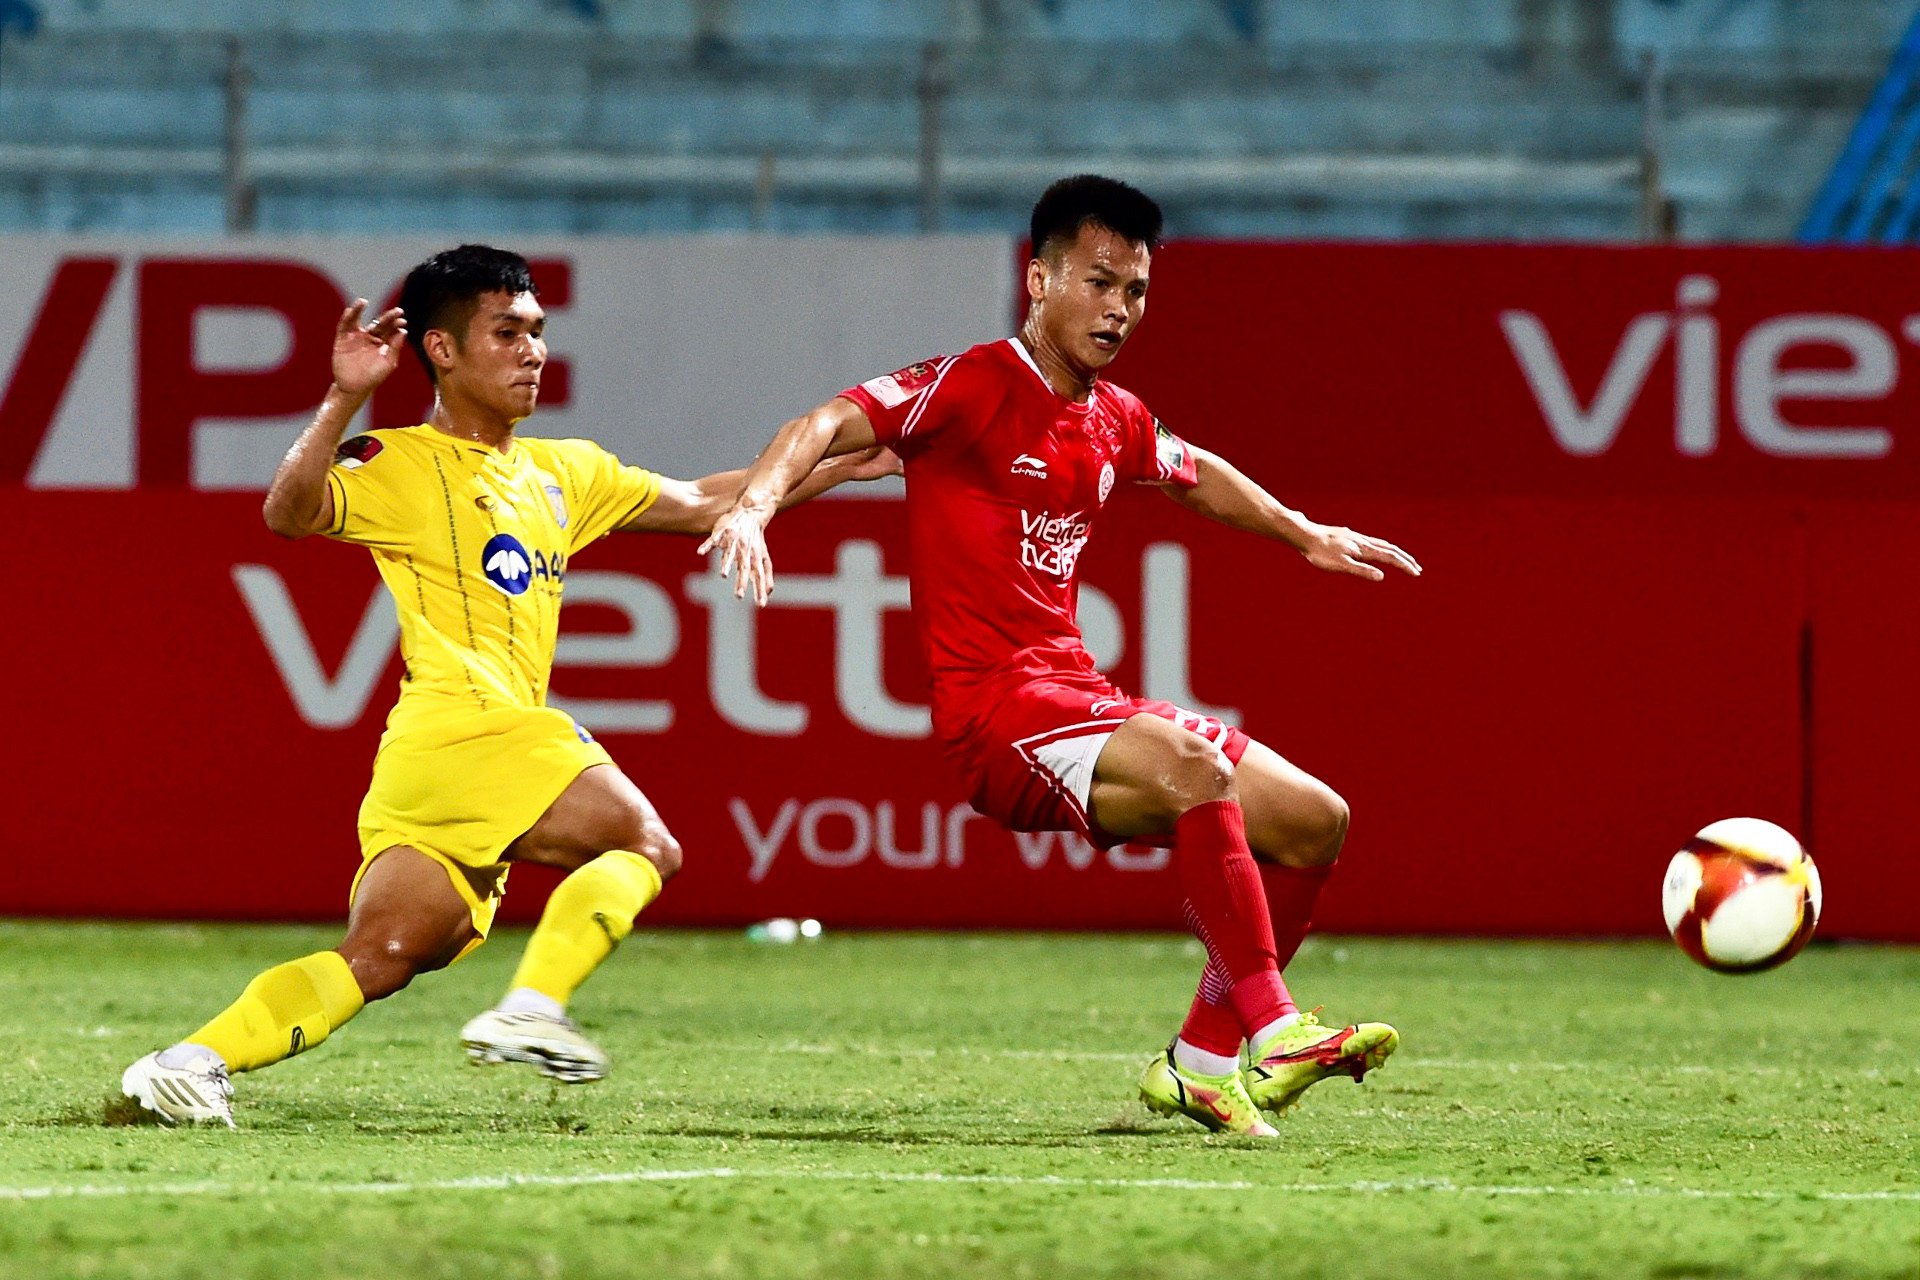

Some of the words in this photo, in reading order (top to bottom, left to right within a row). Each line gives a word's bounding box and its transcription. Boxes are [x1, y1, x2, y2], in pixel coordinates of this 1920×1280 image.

[1499, 273, 1920, 459] vie
[1011, 466, 1047, 480] LI-NING
[728, 797, 990, 883] your
